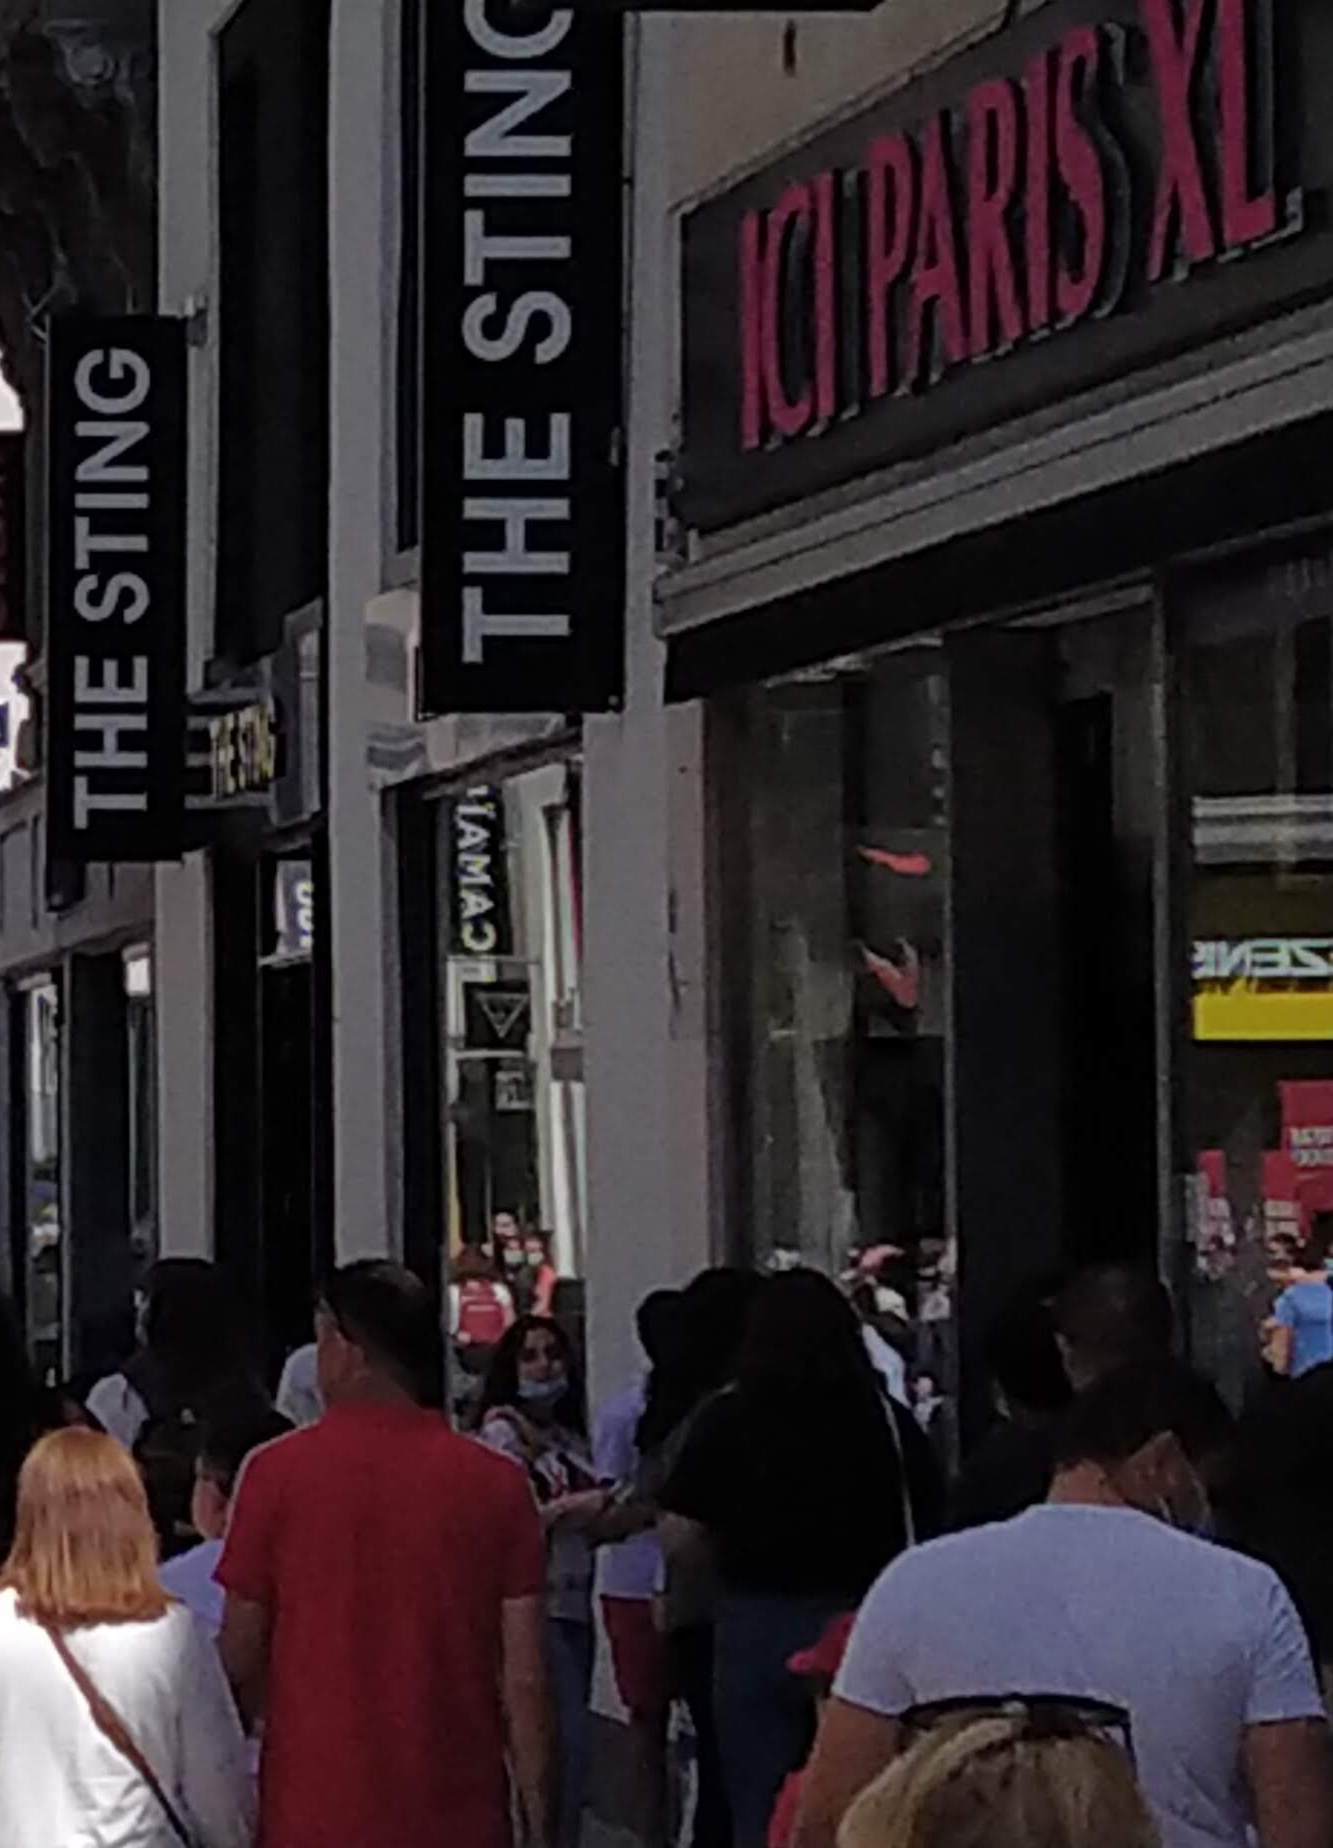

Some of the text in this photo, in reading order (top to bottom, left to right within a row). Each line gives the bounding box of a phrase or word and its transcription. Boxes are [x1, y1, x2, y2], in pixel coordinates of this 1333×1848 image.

[461, 0, 573, 663] THE STING
[741, 0, 1276, 452] ICI PARIS XL
[74, 346, 151, 829] THE STING
